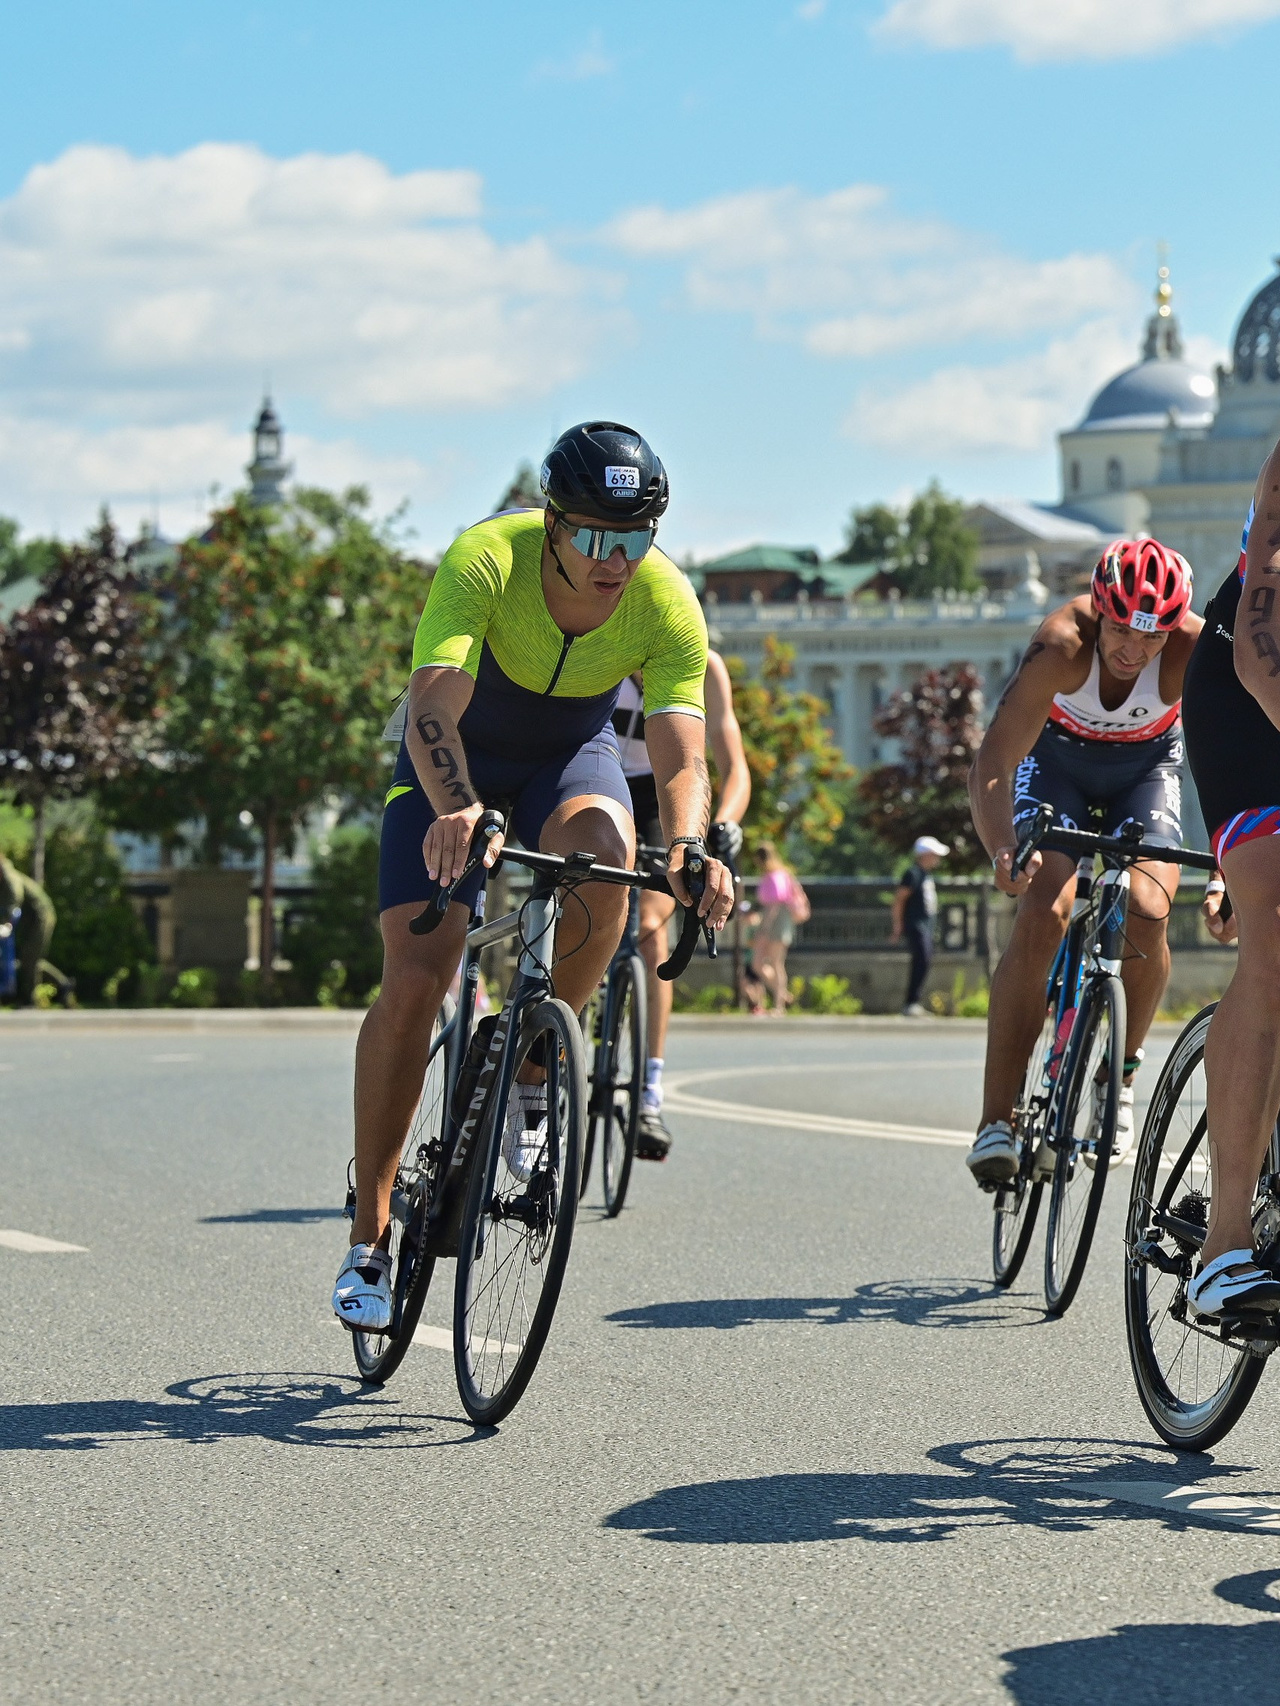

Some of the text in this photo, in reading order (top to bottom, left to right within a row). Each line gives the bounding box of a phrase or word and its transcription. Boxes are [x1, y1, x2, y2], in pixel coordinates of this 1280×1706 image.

[611, 473, 635, 486] 693
[1135, 617, 1153, 630] 716
[416, 712, 473, 811] 693
